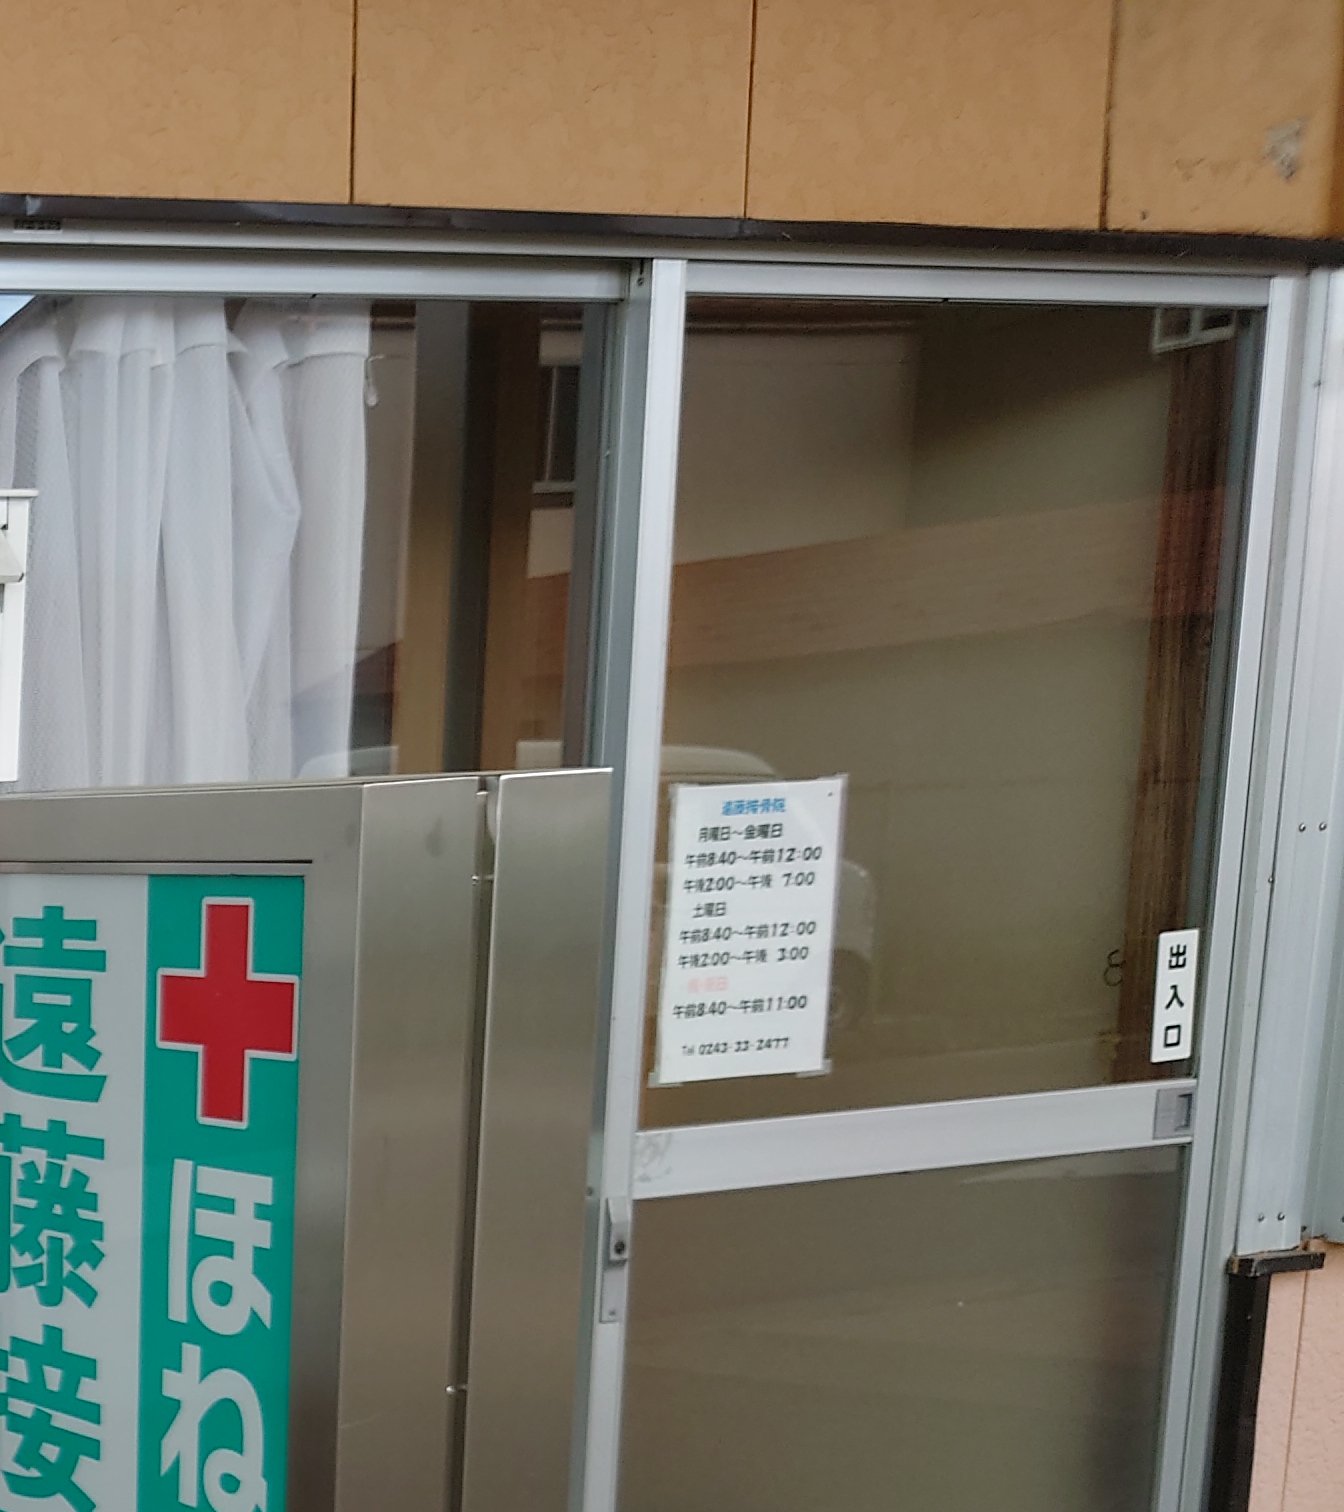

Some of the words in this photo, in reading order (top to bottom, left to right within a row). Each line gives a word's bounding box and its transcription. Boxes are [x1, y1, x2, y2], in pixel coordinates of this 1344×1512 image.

[692, 901, 728, 919] 土曜日
[1162, 943, 1188, 1049] 出入口
